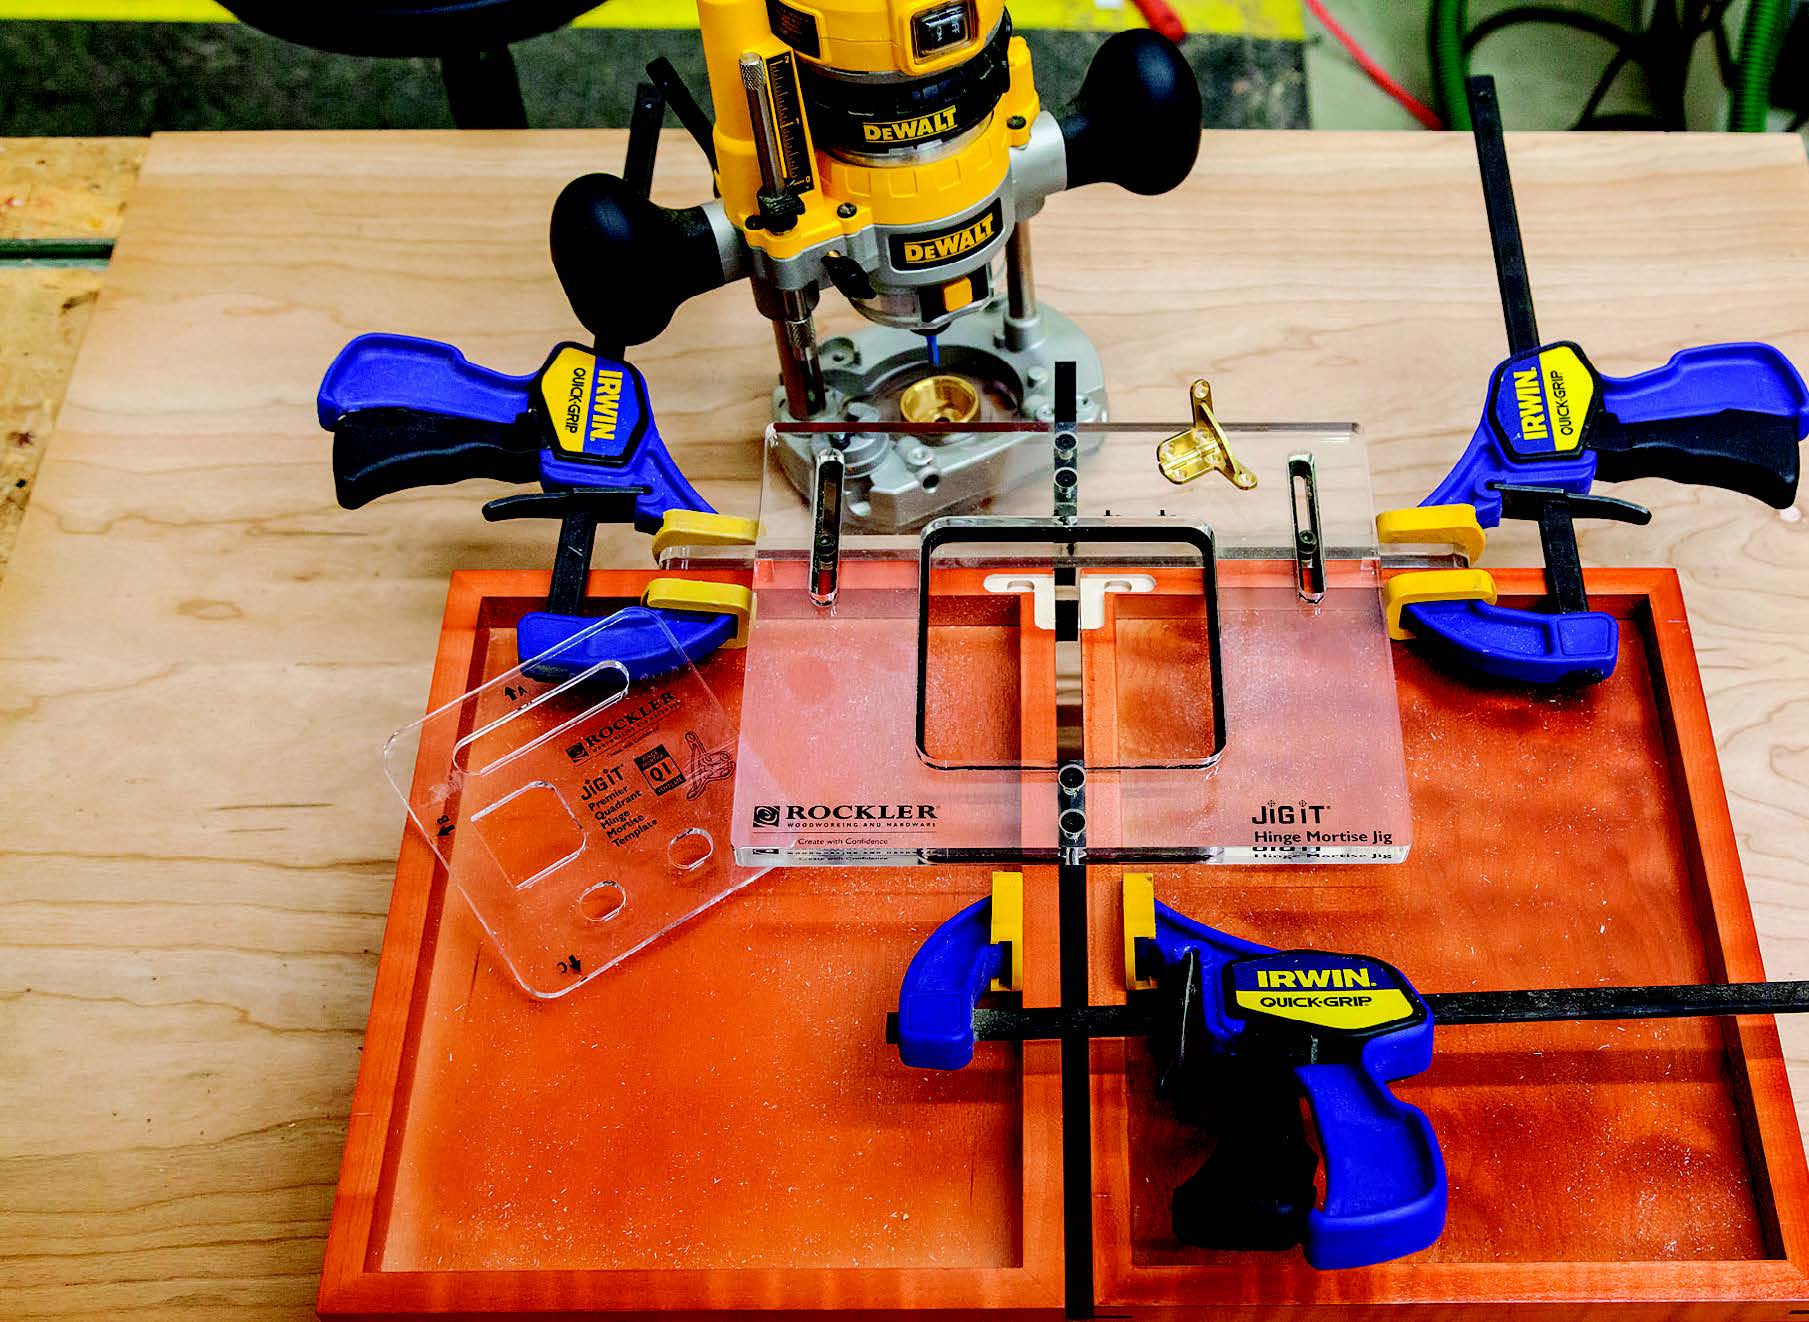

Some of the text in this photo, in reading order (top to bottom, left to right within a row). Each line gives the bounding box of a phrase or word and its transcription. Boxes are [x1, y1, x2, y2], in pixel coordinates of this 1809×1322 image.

[784, 56, 790, 64] 2
[517, 685, 528, 696] A
[584, 691, 676, 748] ROCKLER
[588, 785, 628, 811] Premier
[594, 790, 642, 820] Quadrant
[600, 810, 631, 829] Hinge
[785, 804, 938, 820] ROCKLER
[612, 819, 658, 847] Template
[797, 837, 888, 845] Create with Confidence
[1254, 831, 1393, 845] Hinge Mortise Jig
